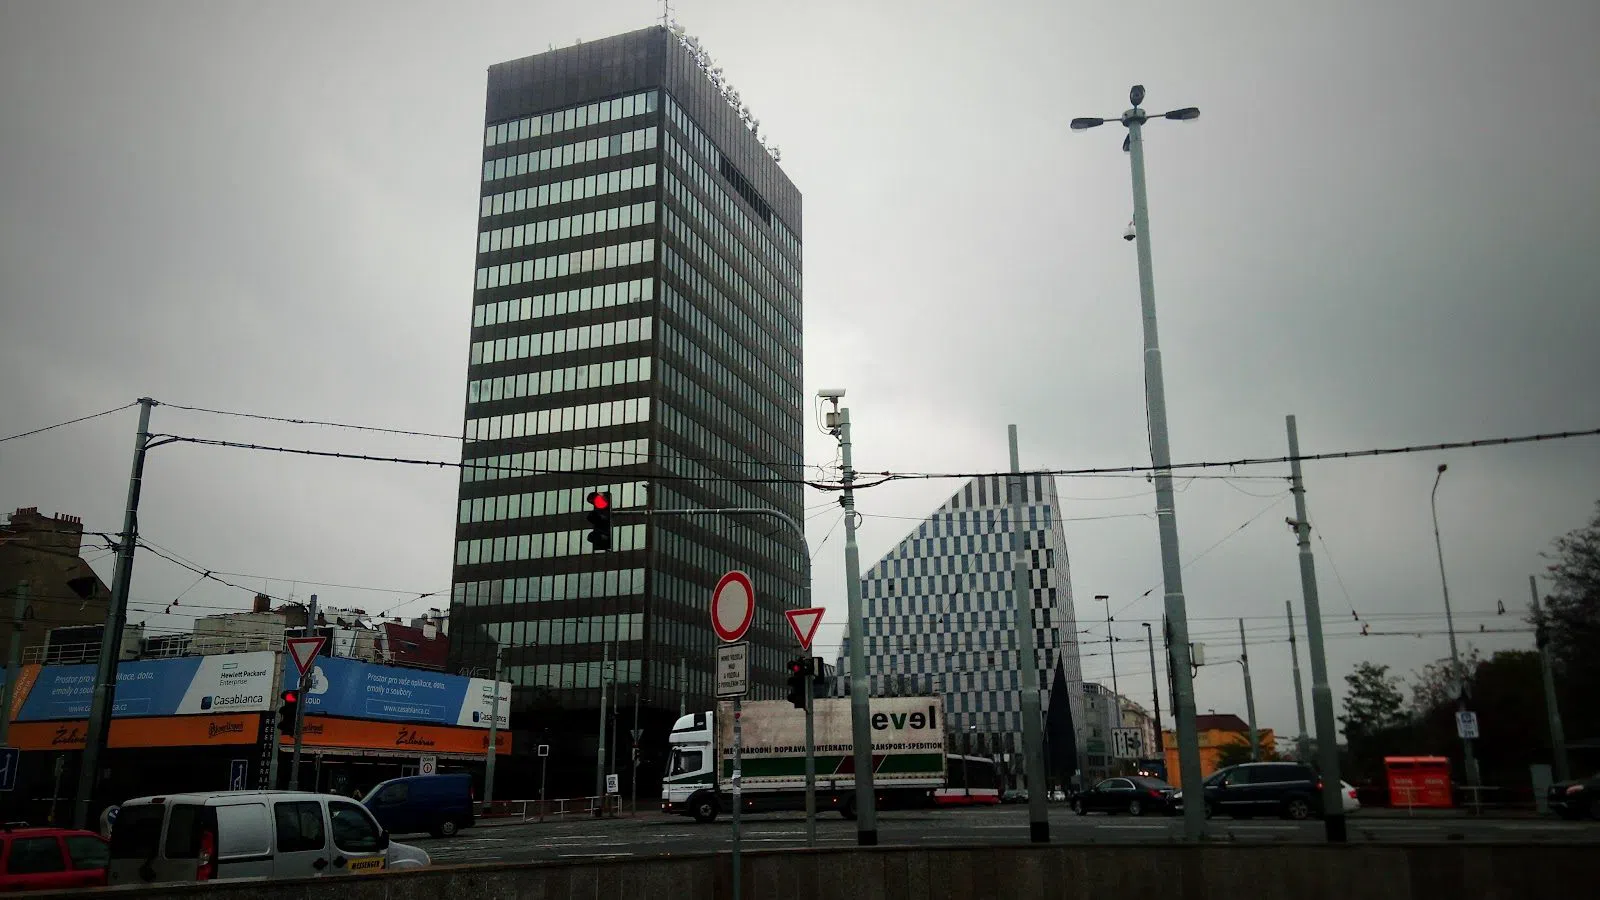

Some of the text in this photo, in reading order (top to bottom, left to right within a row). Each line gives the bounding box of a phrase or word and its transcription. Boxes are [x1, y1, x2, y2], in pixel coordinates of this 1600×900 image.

[368, 672, 388, 683] Prostor
[388, 677, 398, 685] pro
[367, 684, 385, 695] emaily
[213, 694, 263, 706] Casablanca
[304, 697, 321, 705] LOUD
[480, 711, 507, 723] Casaanca
[724, 742, 942, 755] MENÁRODNÍ DOPRAVA INTERNATIO RANSPORT-SPEDITION
